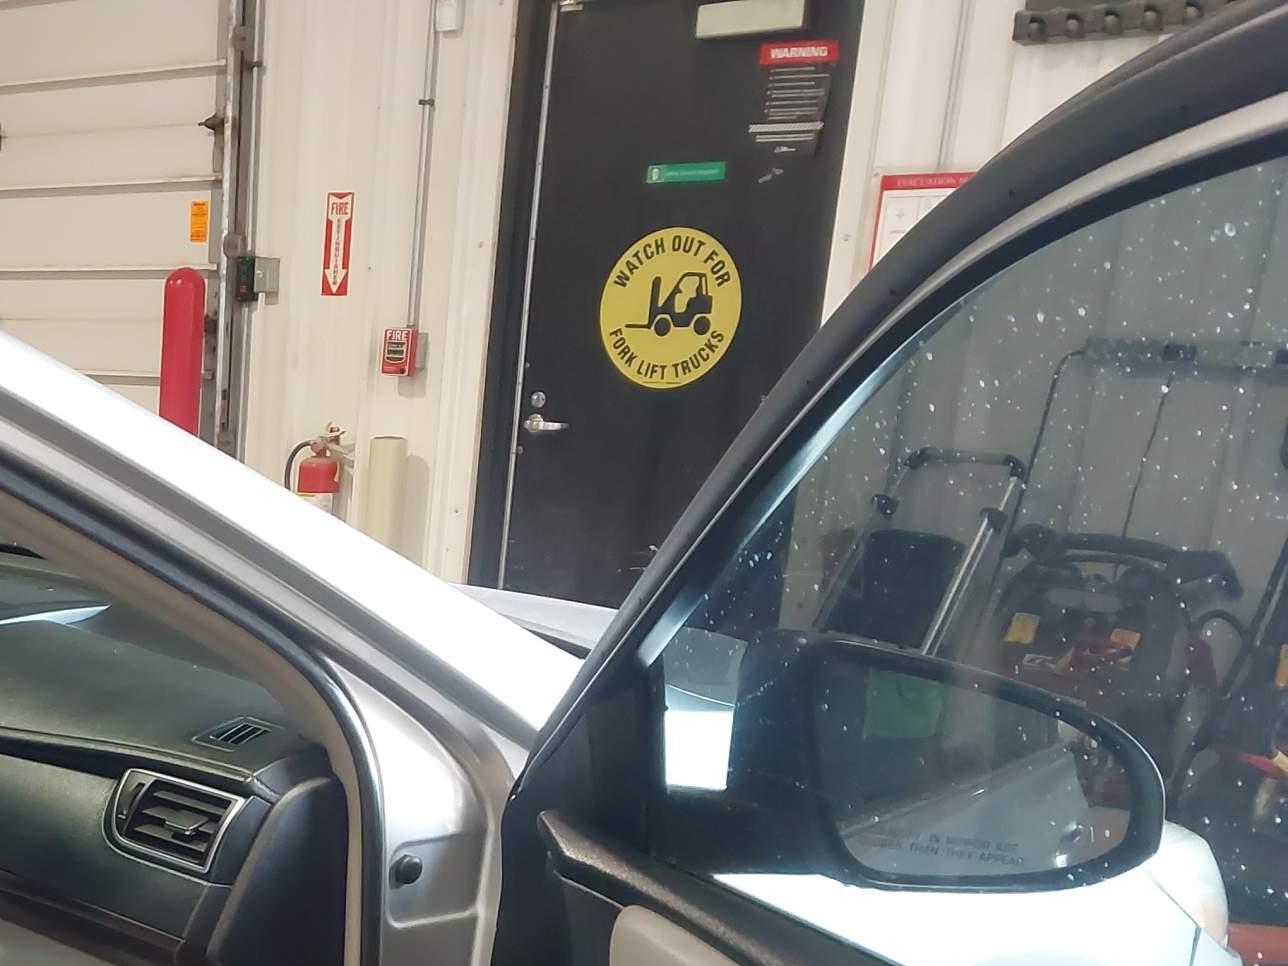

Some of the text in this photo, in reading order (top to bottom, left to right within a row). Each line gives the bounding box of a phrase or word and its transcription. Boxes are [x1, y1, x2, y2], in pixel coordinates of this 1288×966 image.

[770, 46, 829, 59] WARNING
[331, 202, 349, 215] FIRE
[613, 235, 731, 288] WATCH OUT FOR
[386, 330, 409, 341] FIRE
[609, 328, 725, 380] FORK LIFT TRUCKS
